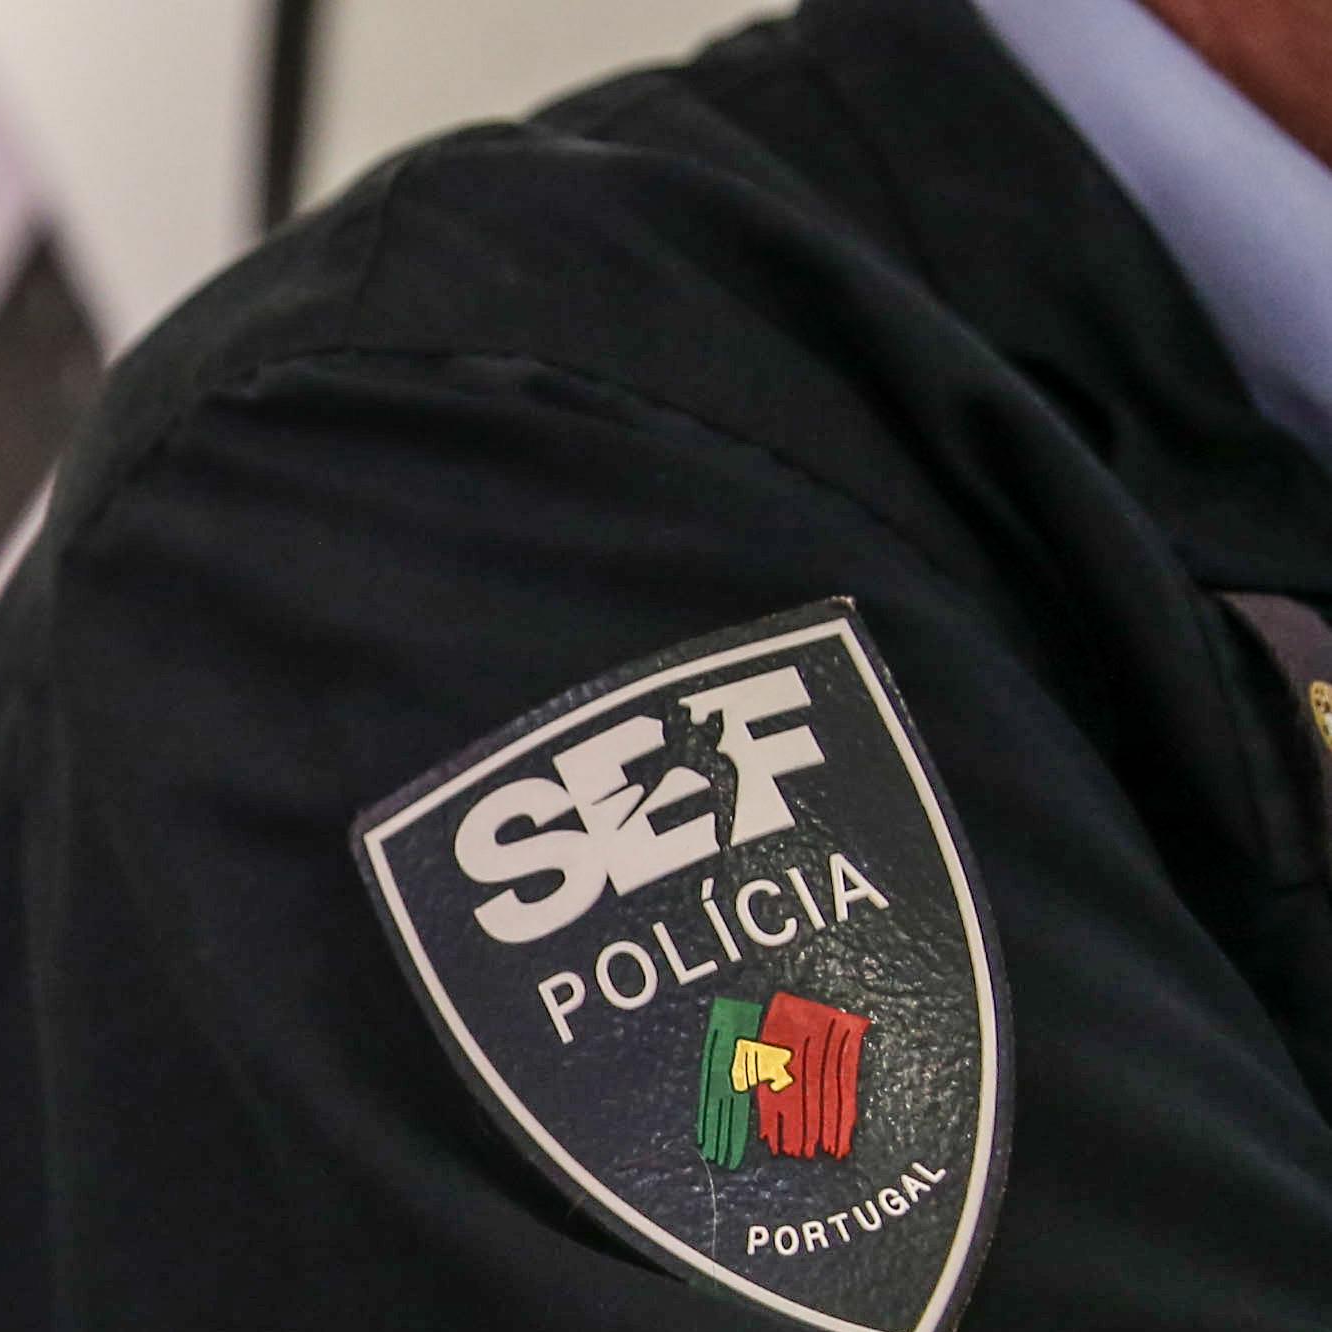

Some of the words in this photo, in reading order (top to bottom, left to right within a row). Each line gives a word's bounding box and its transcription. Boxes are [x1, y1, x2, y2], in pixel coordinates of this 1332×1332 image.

[455, 666, 825, 944] SEF
[538, 853, 888, 1043] POLÍCIA
[747, 1161, 945, 1256] PORTUGAL
